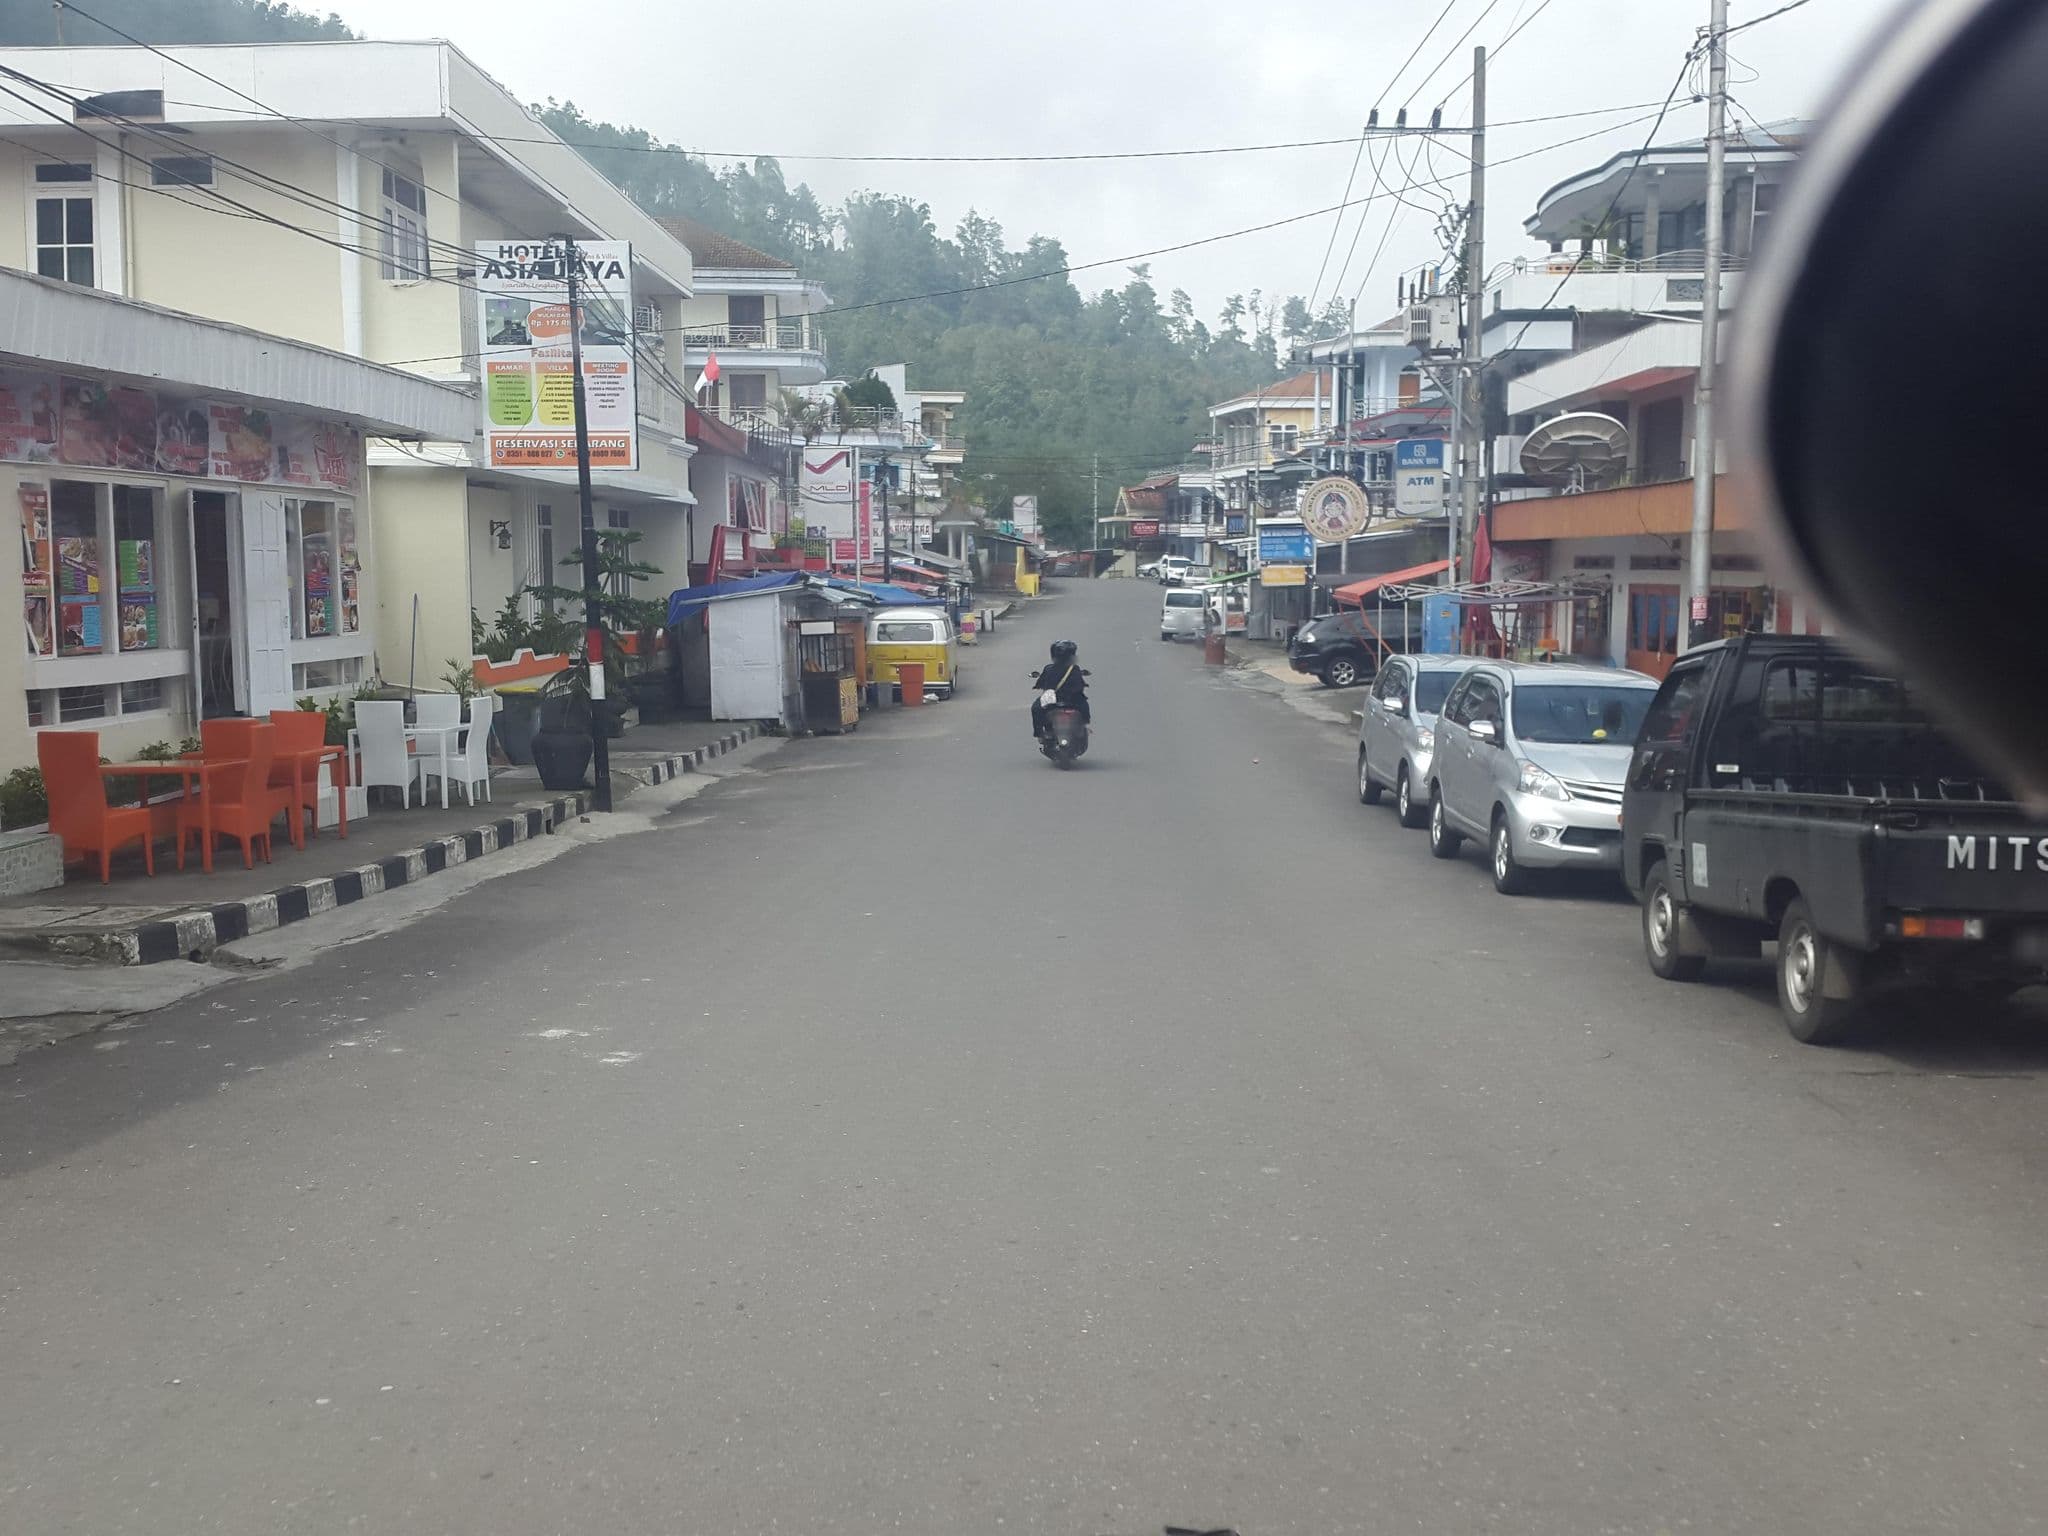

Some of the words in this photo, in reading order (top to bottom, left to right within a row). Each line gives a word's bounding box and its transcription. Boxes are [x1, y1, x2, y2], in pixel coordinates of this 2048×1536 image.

[499, 245, 566, 259] HOTEL
[495, 440, 558, 449] RESERVASI
[561, 439, 626, 449] SEARANG
[1402, 458, 1424, 466] BANK
[1407, 476, 1435, 486] ATM
[1947, 835, 2048, 872] MITS
